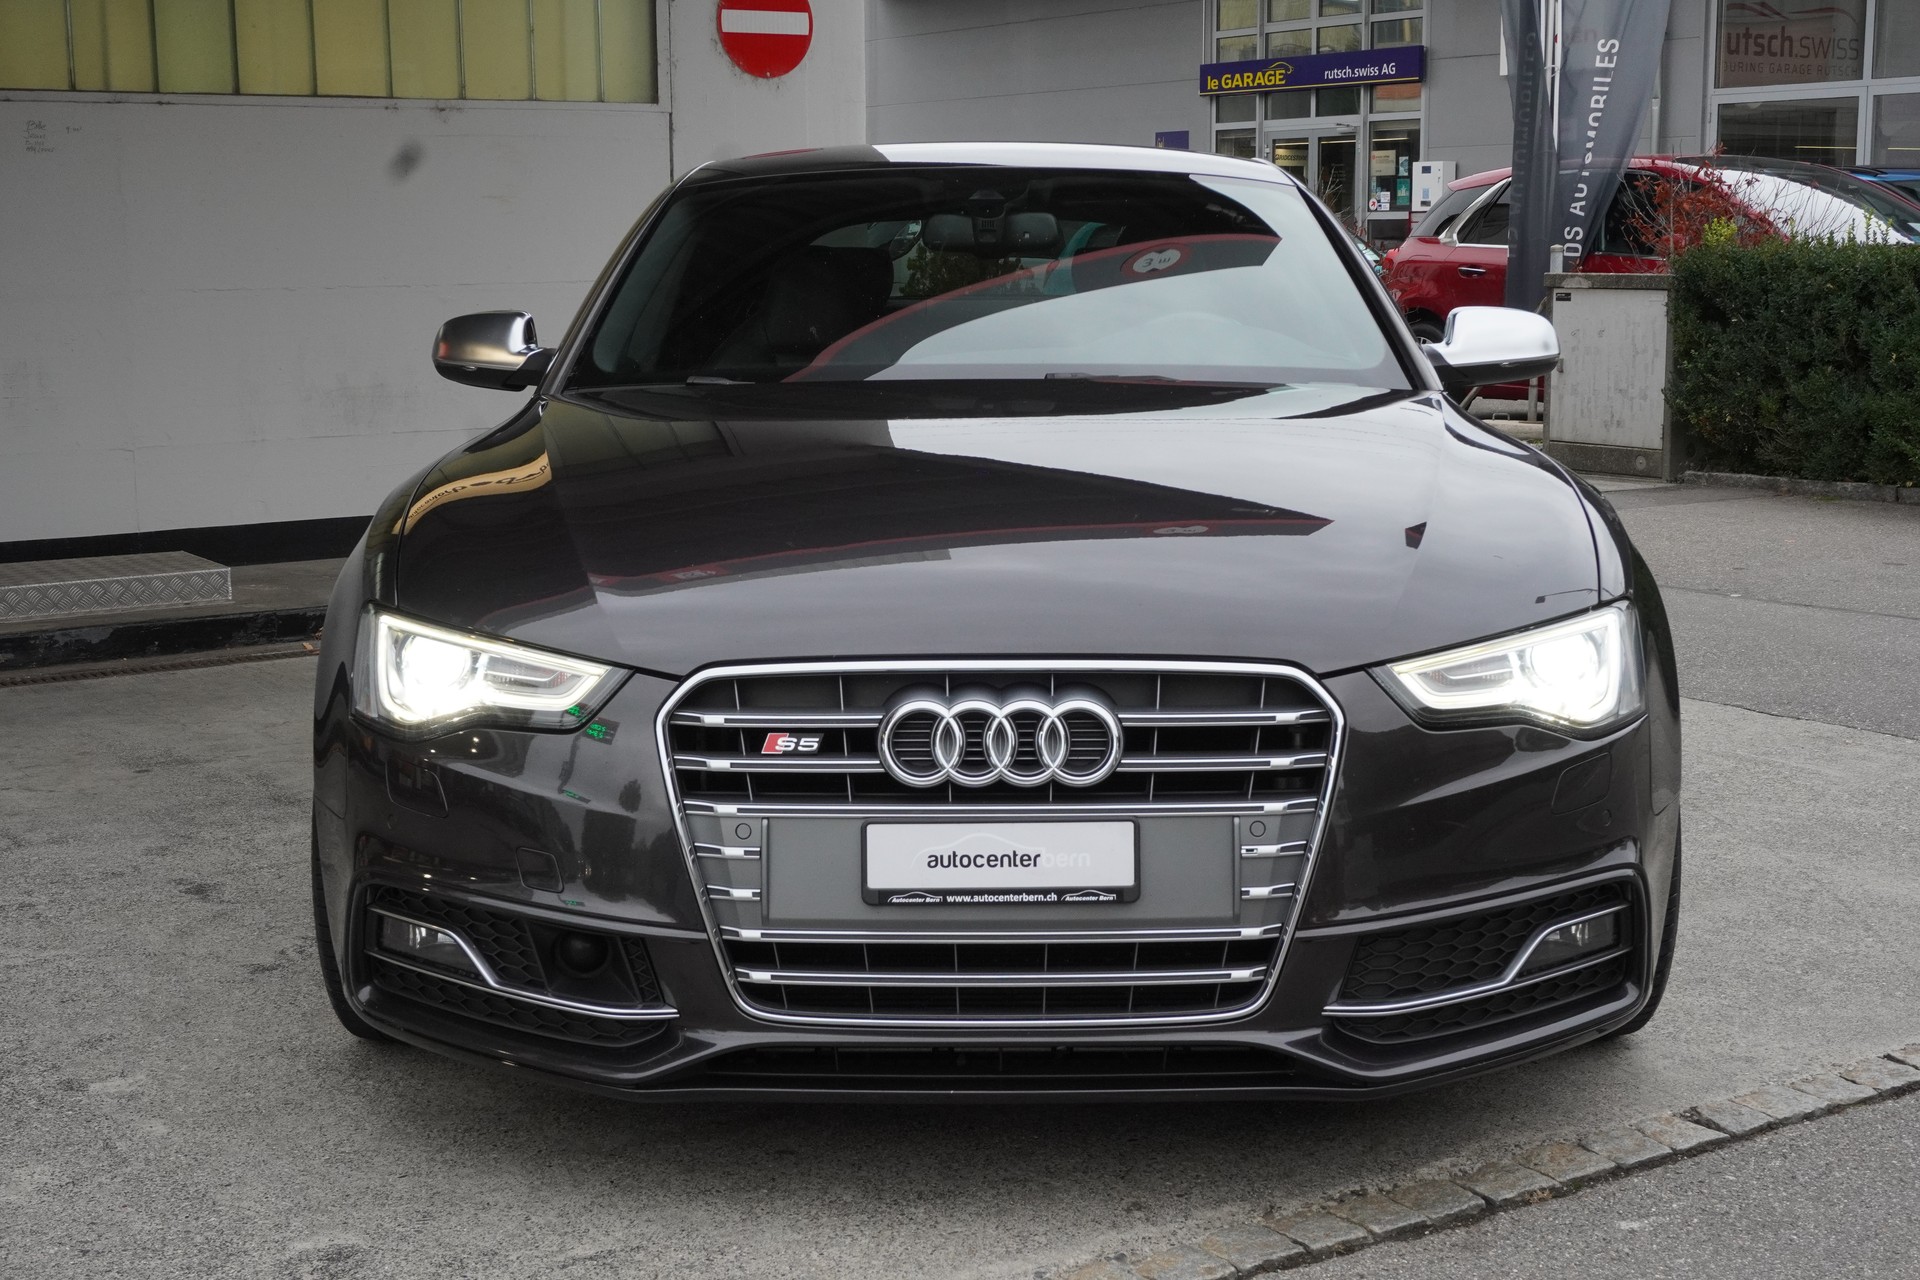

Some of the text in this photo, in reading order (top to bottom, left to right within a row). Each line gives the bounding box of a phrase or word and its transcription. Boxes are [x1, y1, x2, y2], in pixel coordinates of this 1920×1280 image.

[1726, 26, 1859, 60] utsch.swiss
[1324, 62, 1397, 80] rutsch.swiss AG
[1724, 61, 1858, 77] URING GARAGE RUTSCH
[1207, 69, 1286, 90] le GARAGE
[1563, 226, 1584, 257] DS
[774, 736, 820, 751] S5
[946, 892, 1058, 903] www.autocenterbern.ch
